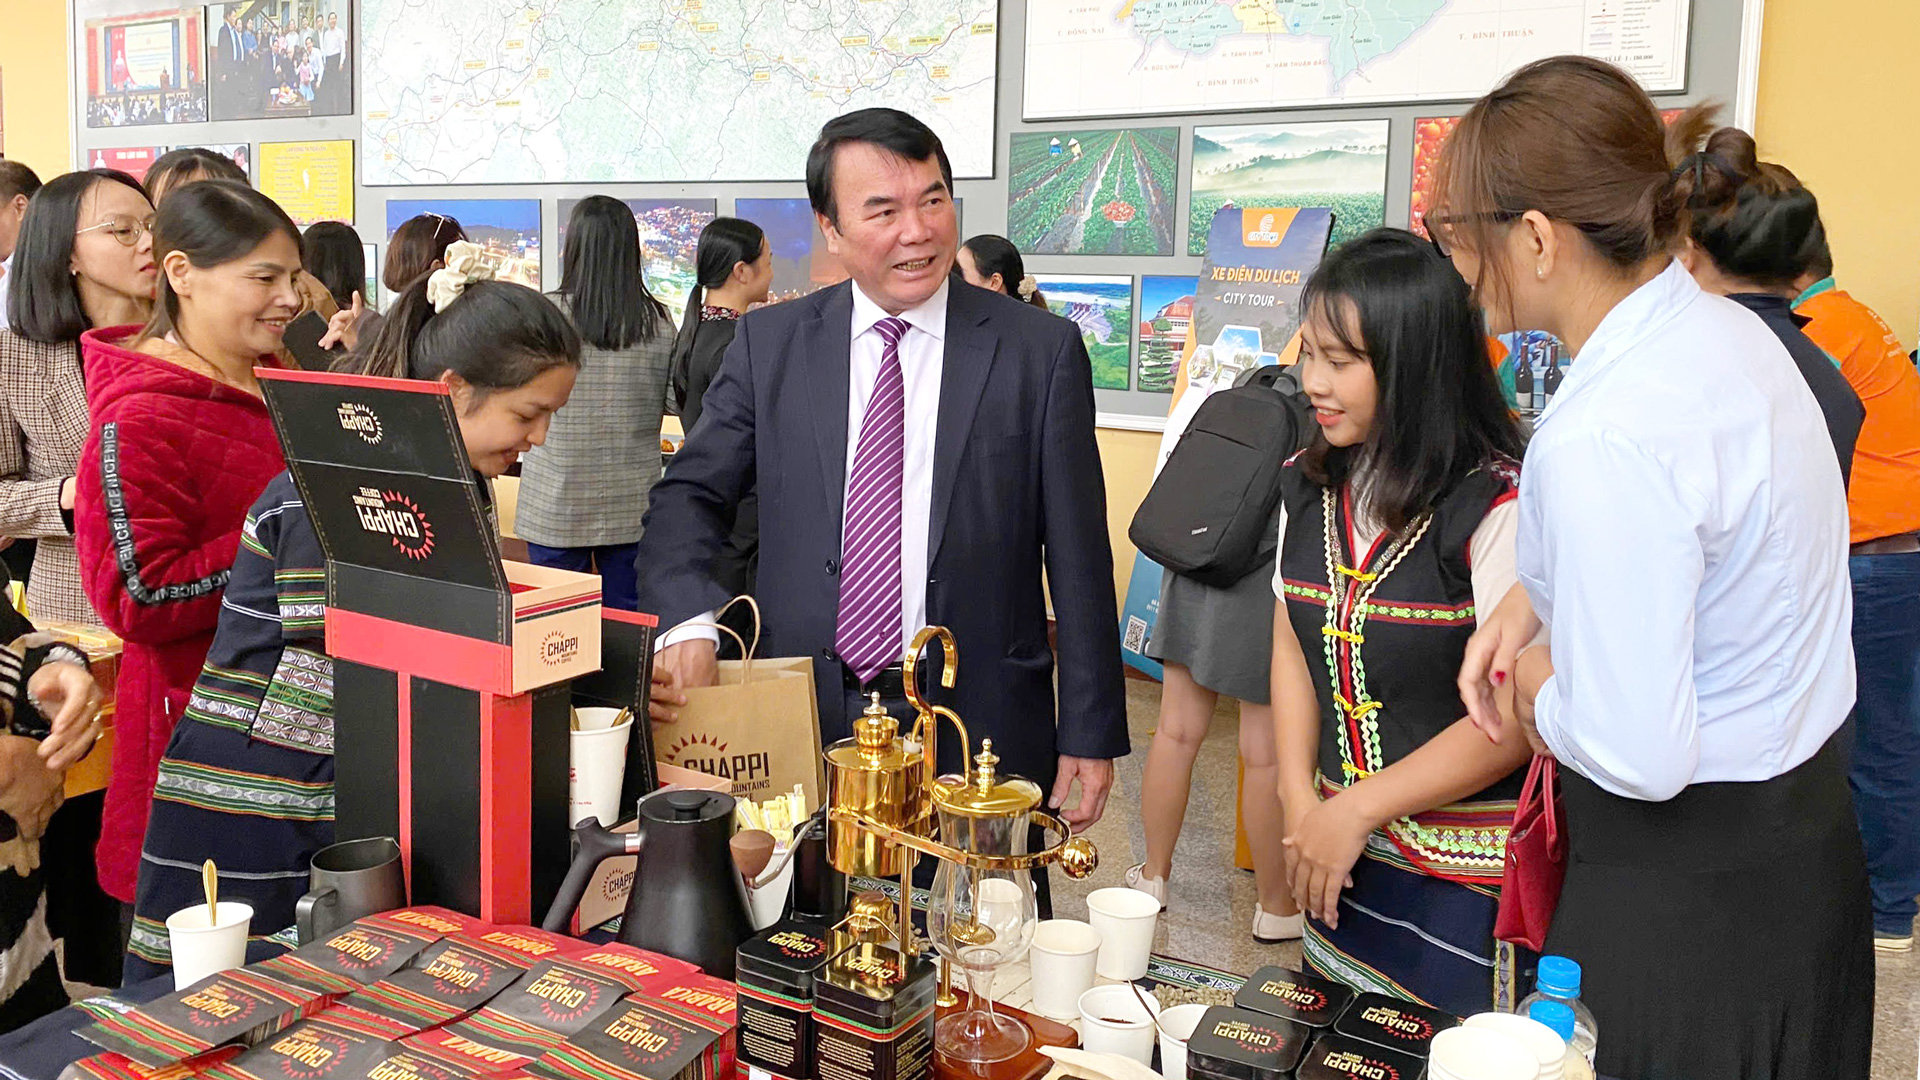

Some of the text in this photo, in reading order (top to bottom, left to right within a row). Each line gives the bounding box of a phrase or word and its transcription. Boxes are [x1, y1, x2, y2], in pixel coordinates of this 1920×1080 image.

[1211, 264, 1301, 287] XE ĐIỆN DU LỊCH
[1223, 292, 1275, 307] CITY TOUR
[339, 413, 375, 432] CHAPPI
[355, 505, 420, 539] CHAPPI
[547, 636, 579, 657] CHAPPI
[731, 779, 770, 793] OUNTAINS
[609, 871, 634, 893] CHAPP
[325, 935, 383, 962] CHAPPI
[767, 933, 816, 954] CHAPPI
[422, 960, 479, 989] CHAPPI
[580, 953, 660, 977] ARABICA
[844, 958, 896, 980] CHAPPI
[180, 992, 241, 1018] CHAPPI
[525, 978, 587, 1009] CHAPPI
[660, 986, 737, 1015] ARABICA
[1259, 982, 1315, 1005] CHAPPI
[1360, 1007, 1420, 1034] CHAPPI
[604, 1019, 669, 1053] CHAPPI
[1212, 1024, 1272, 1047] CHAPPI
[270, 1036, 334, 1068] CHAPPI
[1322, 1055, 1385, 1080] CHAPPI
